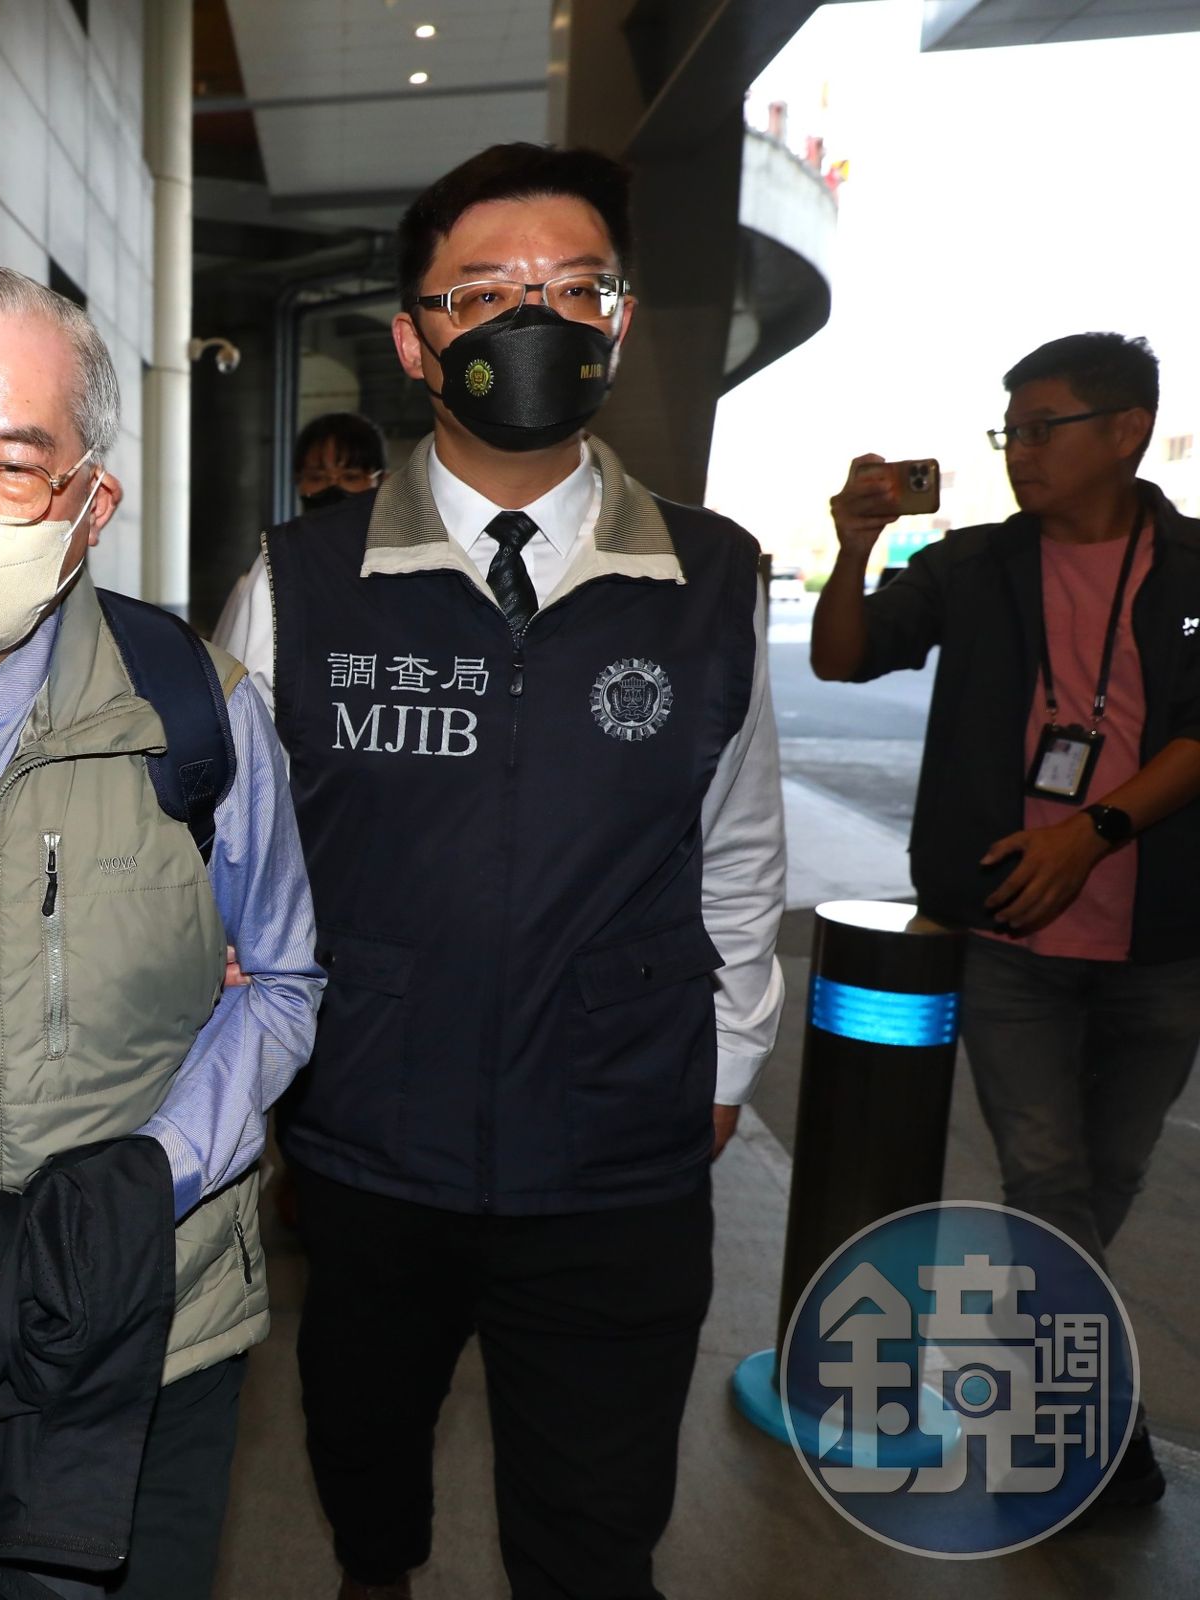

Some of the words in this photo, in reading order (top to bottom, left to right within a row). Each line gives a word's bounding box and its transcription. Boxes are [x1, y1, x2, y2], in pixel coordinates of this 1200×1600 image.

[580, 363, 602, 379] MJIB
[327, 652, 490, 696] 調查局
[331, 702, 479, 757] MJIB
